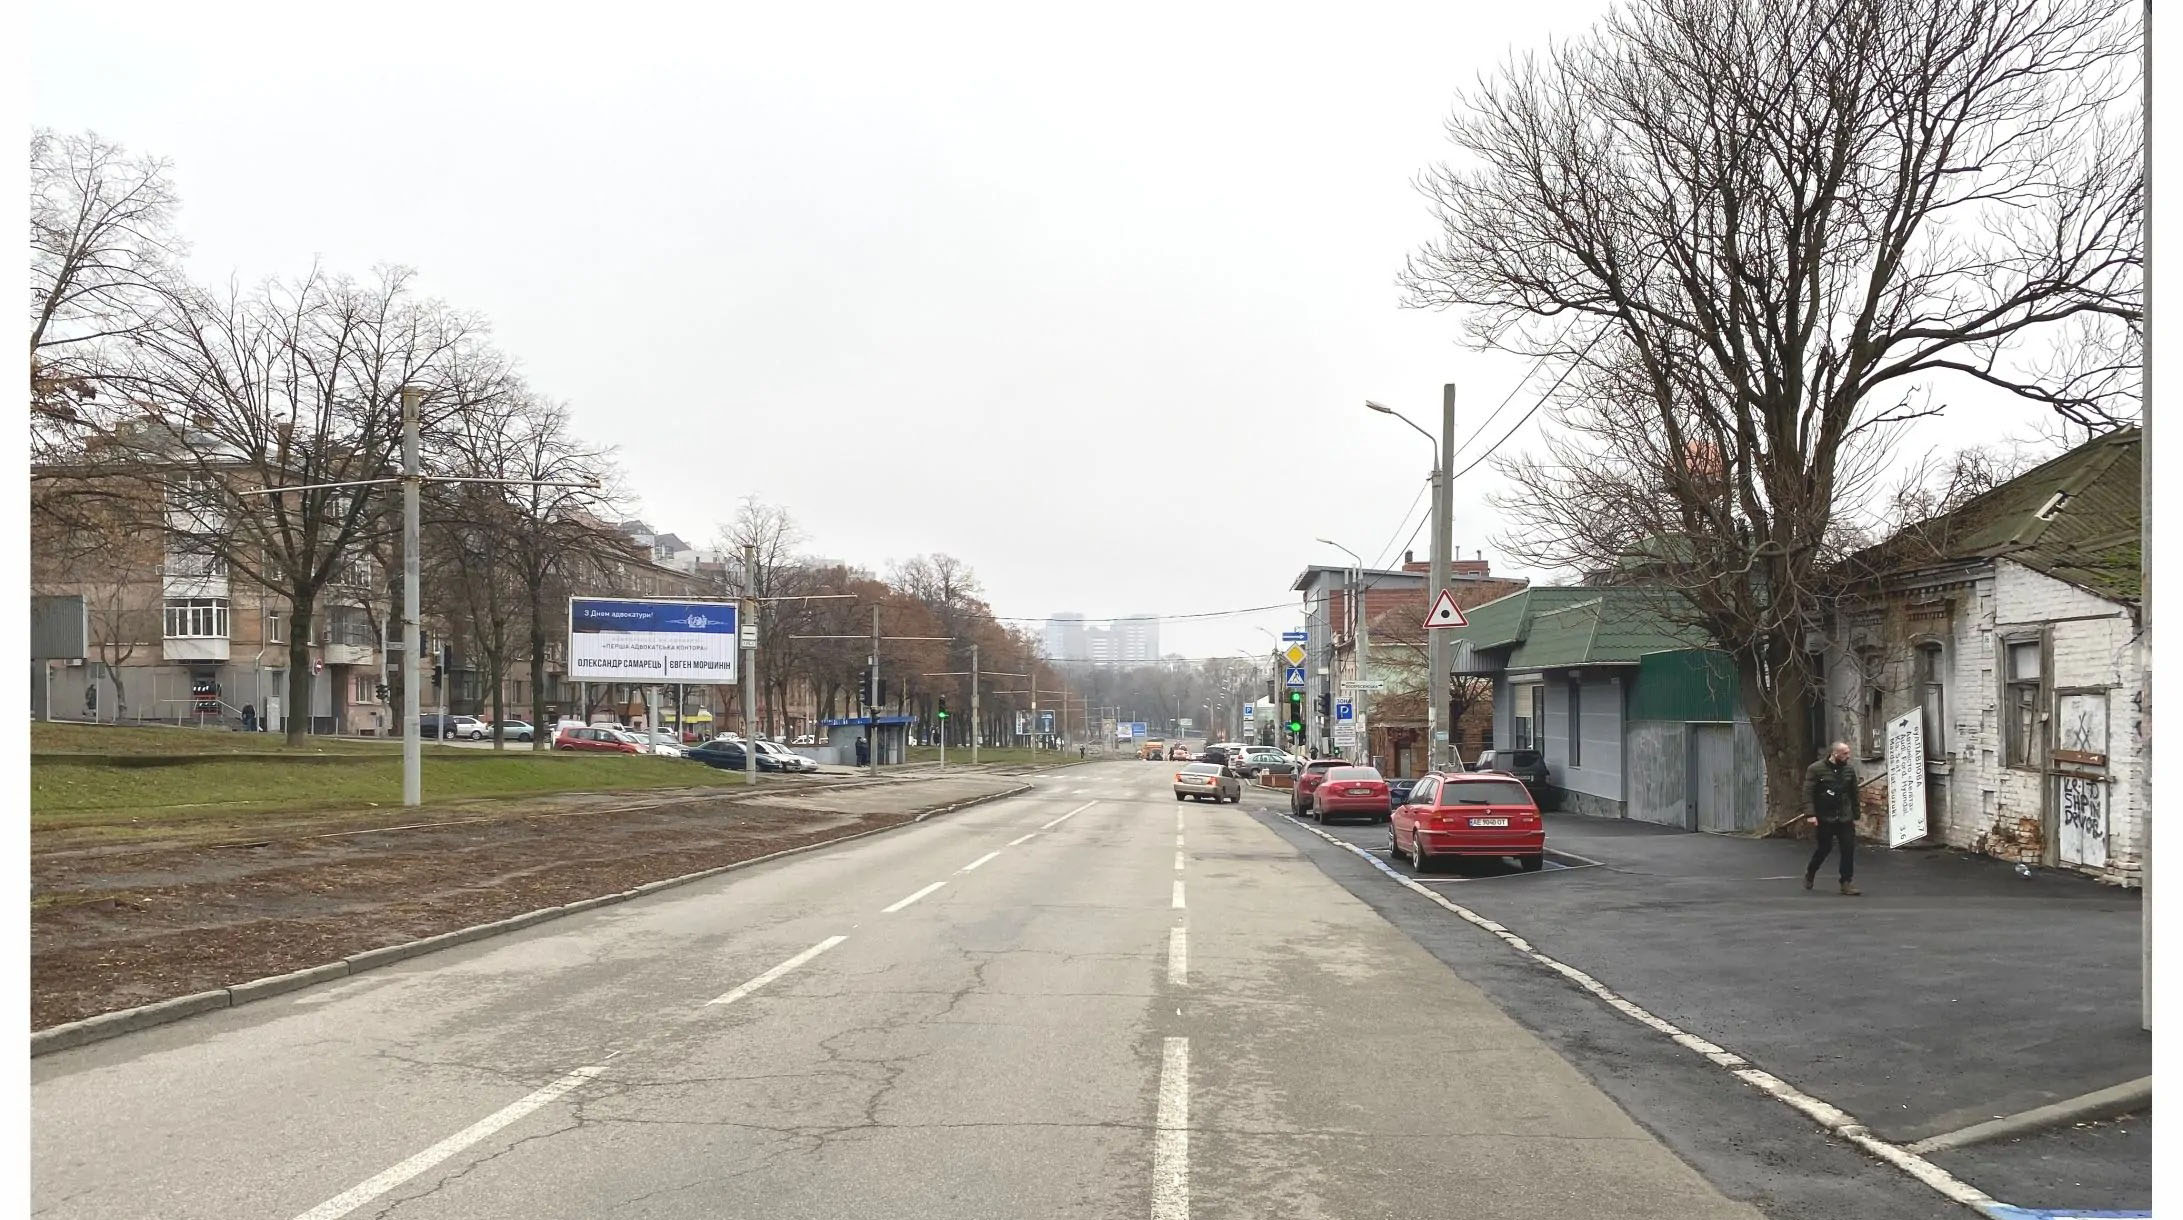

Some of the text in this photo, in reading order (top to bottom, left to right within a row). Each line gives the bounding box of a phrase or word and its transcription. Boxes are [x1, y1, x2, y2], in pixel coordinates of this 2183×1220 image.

[584, 609, 654, 620] З Днем адвокатури!
[577, 658, 662, 670] ОЛЕКСАНДР САМАРЕЦЬ
[669, 660, 731, 670] ЄВГЕН МОРШИНІН
